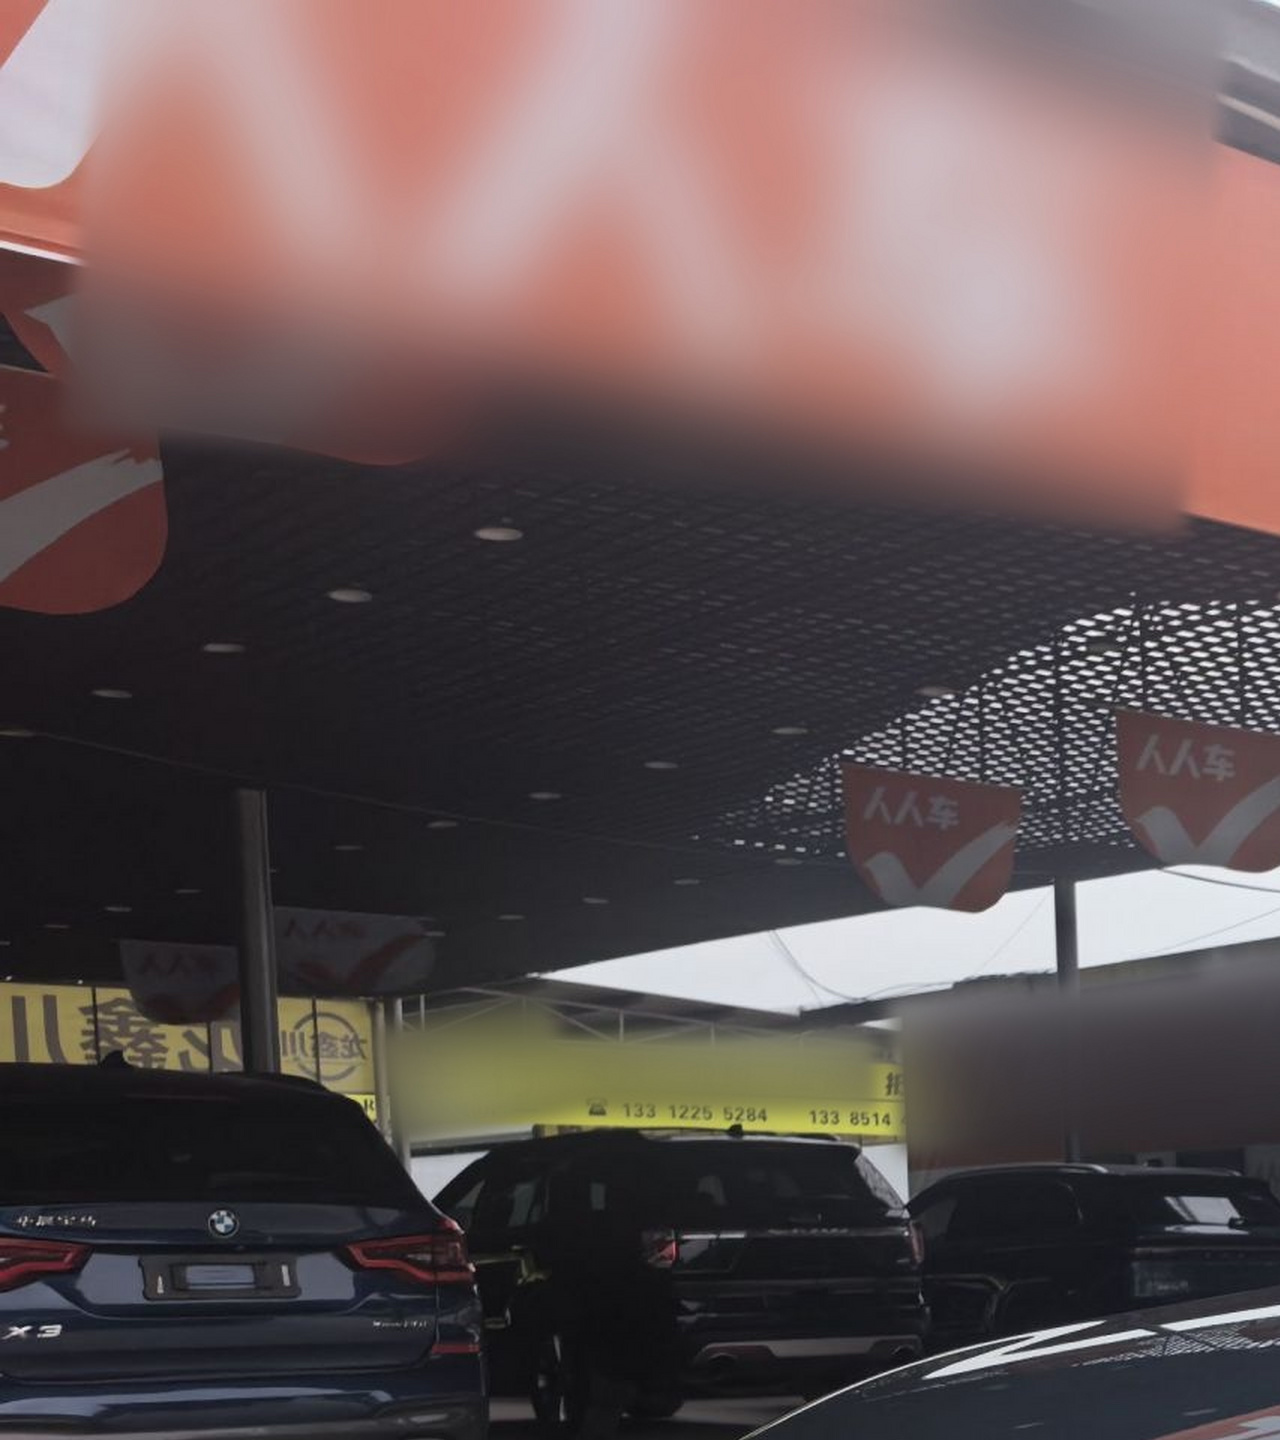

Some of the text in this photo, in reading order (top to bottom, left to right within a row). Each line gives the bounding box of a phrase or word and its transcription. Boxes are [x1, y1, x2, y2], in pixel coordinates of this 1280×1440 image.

[1136, 734, 1236, 782] 人人车
[863, 786, 960, 830] 人人车
[623, 1103, 891, 1126] 133 1225 5284 133 8514
[1, 1323, 63, 1340] X3
